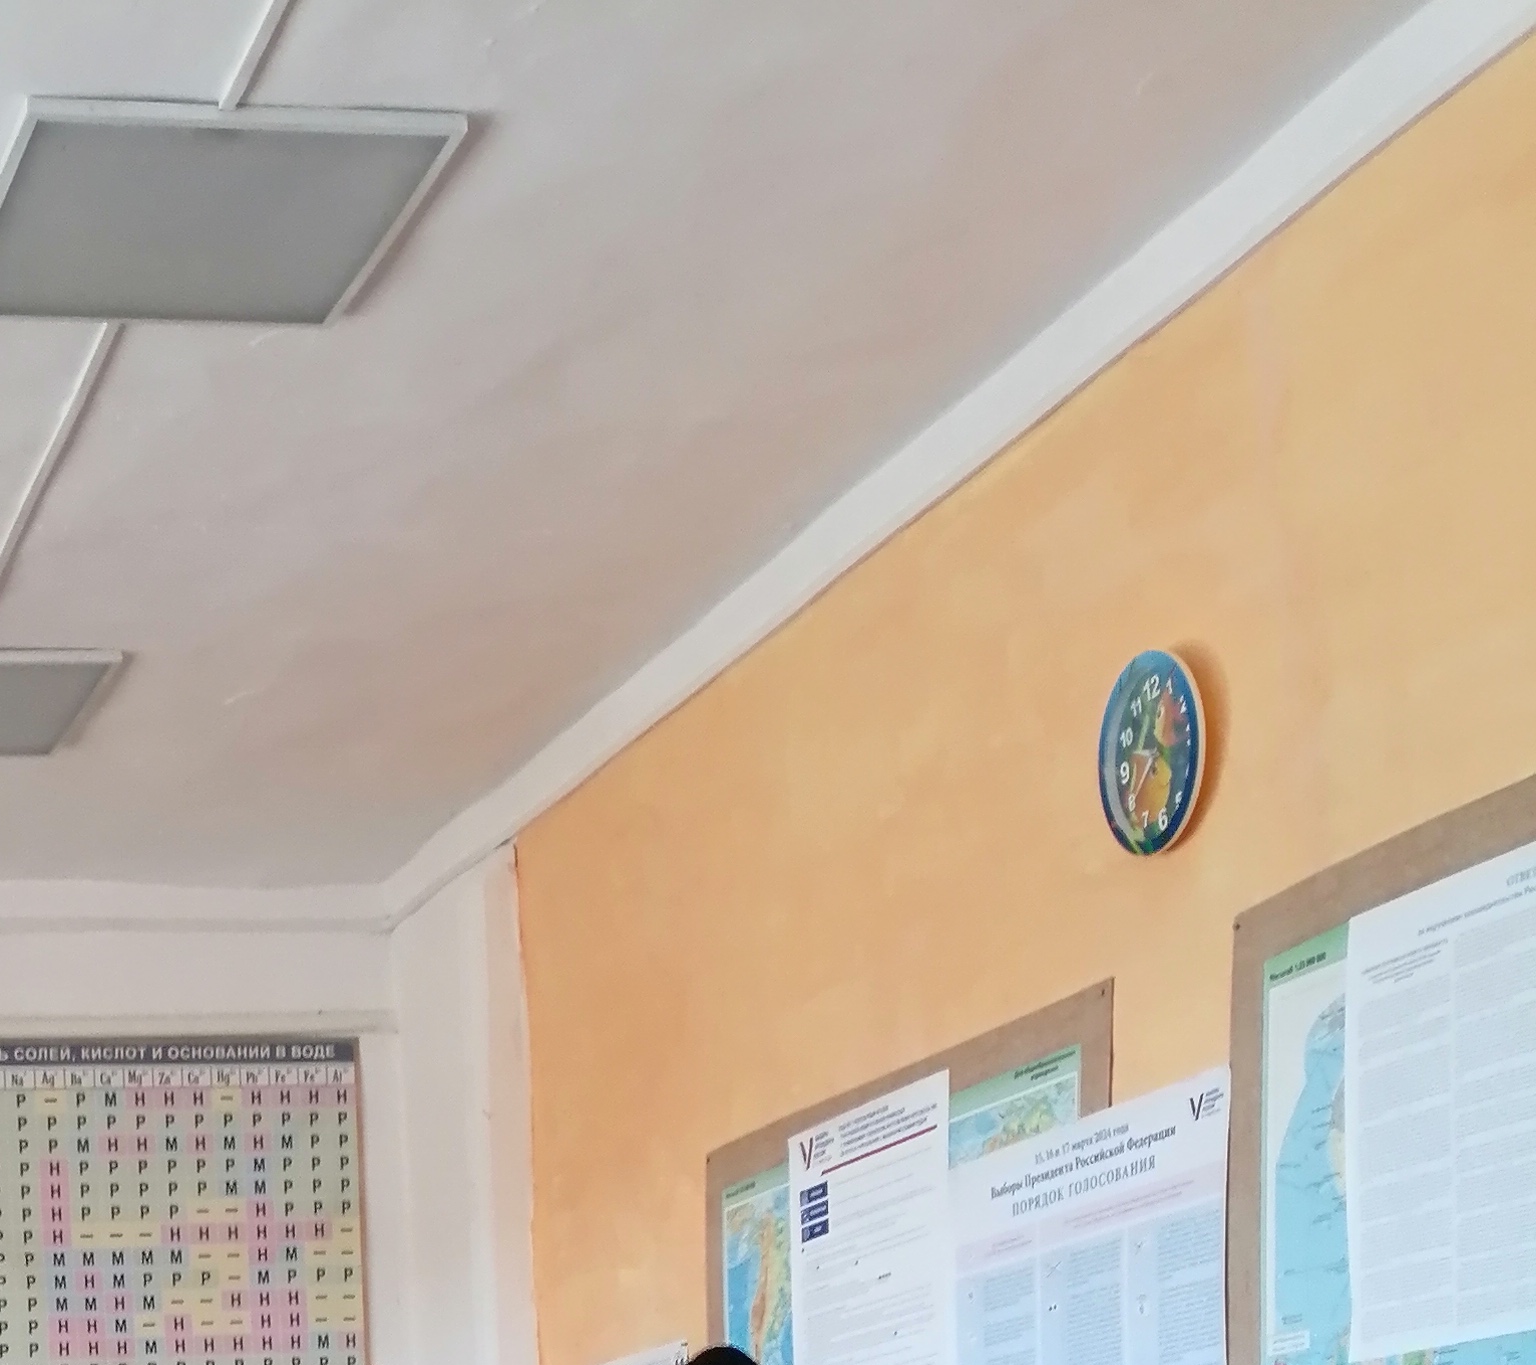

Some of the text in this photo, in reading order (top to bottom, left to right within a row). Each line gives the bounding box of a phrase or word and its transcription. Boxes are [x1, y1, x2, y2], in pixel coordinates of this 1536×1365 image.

[1143, 674, 1161, 701] 12
[1166, 678, 1173, 694] 1
[1131, 697, 1142, 717] 11
[1120, 727, 1133, 748] 10
[1120, 762, 1130, 784] 9
[1128, 794, 1136, 812] 8
[1141, 810, 1151, 828] 7
[1158, 807, 1168, 830] 6
[81, 1046, 145, 1061] КИСЛОТ
[152, 1045, 162, 1060] И
[276, 1045, 286, 1059] В
[291, 1044, 335, 1060] ВОДЕ
[1071, 1136, 1093, 1153] марта
[1094, 1129, 1112, 1144] 2024
[1112, 1123, 1129, 1137] года
[991, 1125, 1176, 1200] Выборы Президента Российской Федерации
[1012, 1186, 1064, 1217] ПОРЯДОК
[1067, 1155, 1156, 1198] ГОЛОСОВАНИЯ
